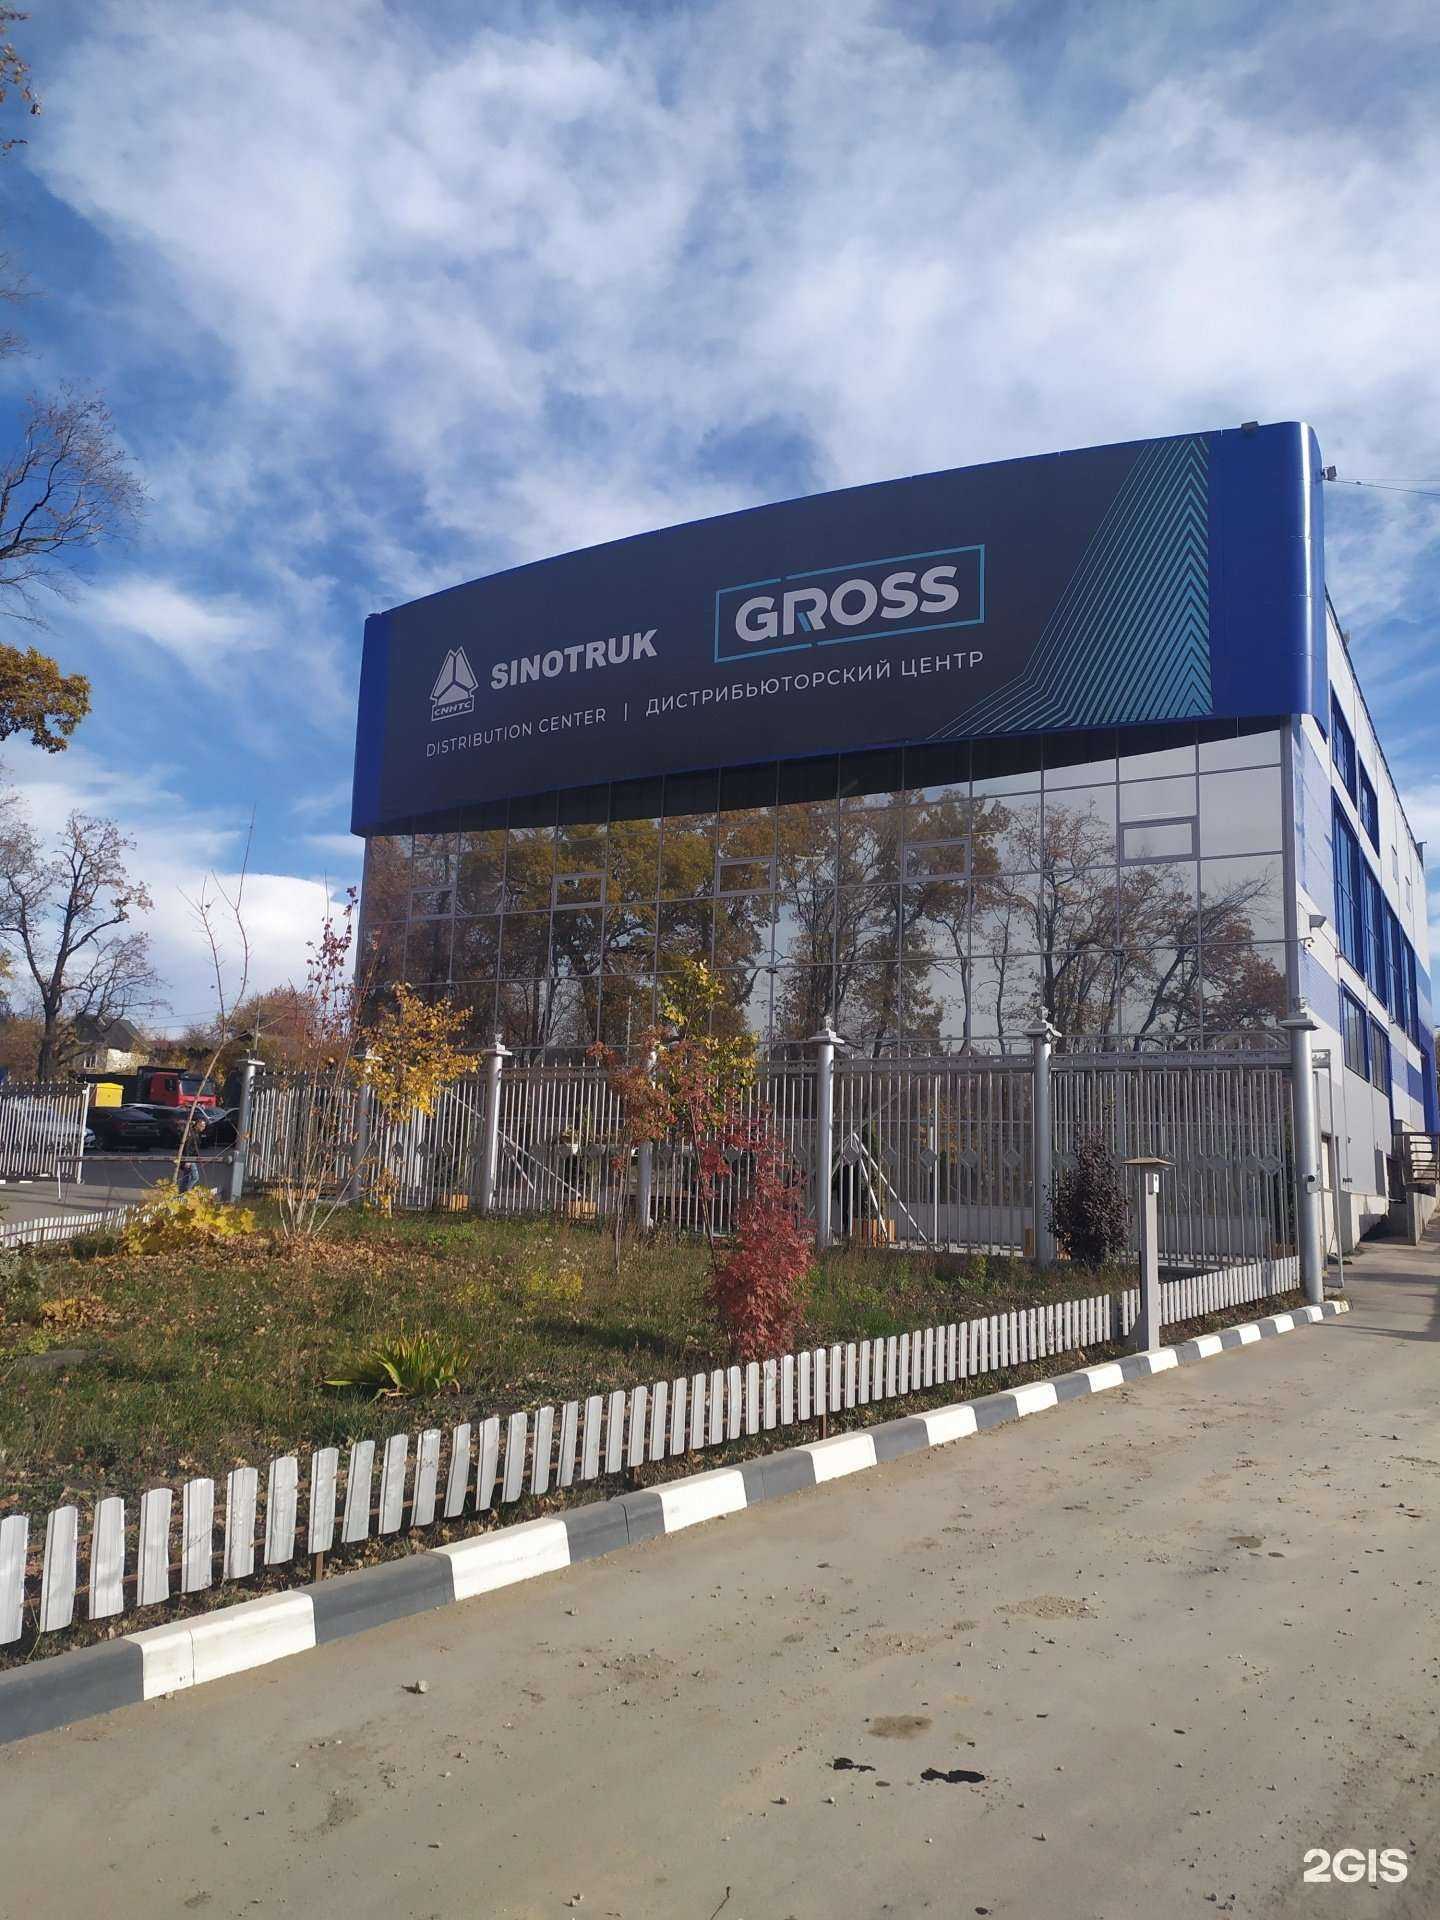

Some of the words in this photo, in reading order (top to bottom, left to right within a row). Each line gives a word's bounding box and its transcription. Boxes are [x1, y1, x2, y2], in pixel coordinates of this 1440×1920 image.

[735, 565, 959, 642] GROSS
[490, 629, 658, 690] SINOTRUK
[645, 659, 891, 717] ДИСТРИБЬЮТОРСКИЙ
[901, 650, 984, 677] ЦЕНТР
[426, 722, 532, 757] DISTRIBUTION
[538, 707, 607, 733] CENTER
[434, 701, 472, 717] CNHTC
